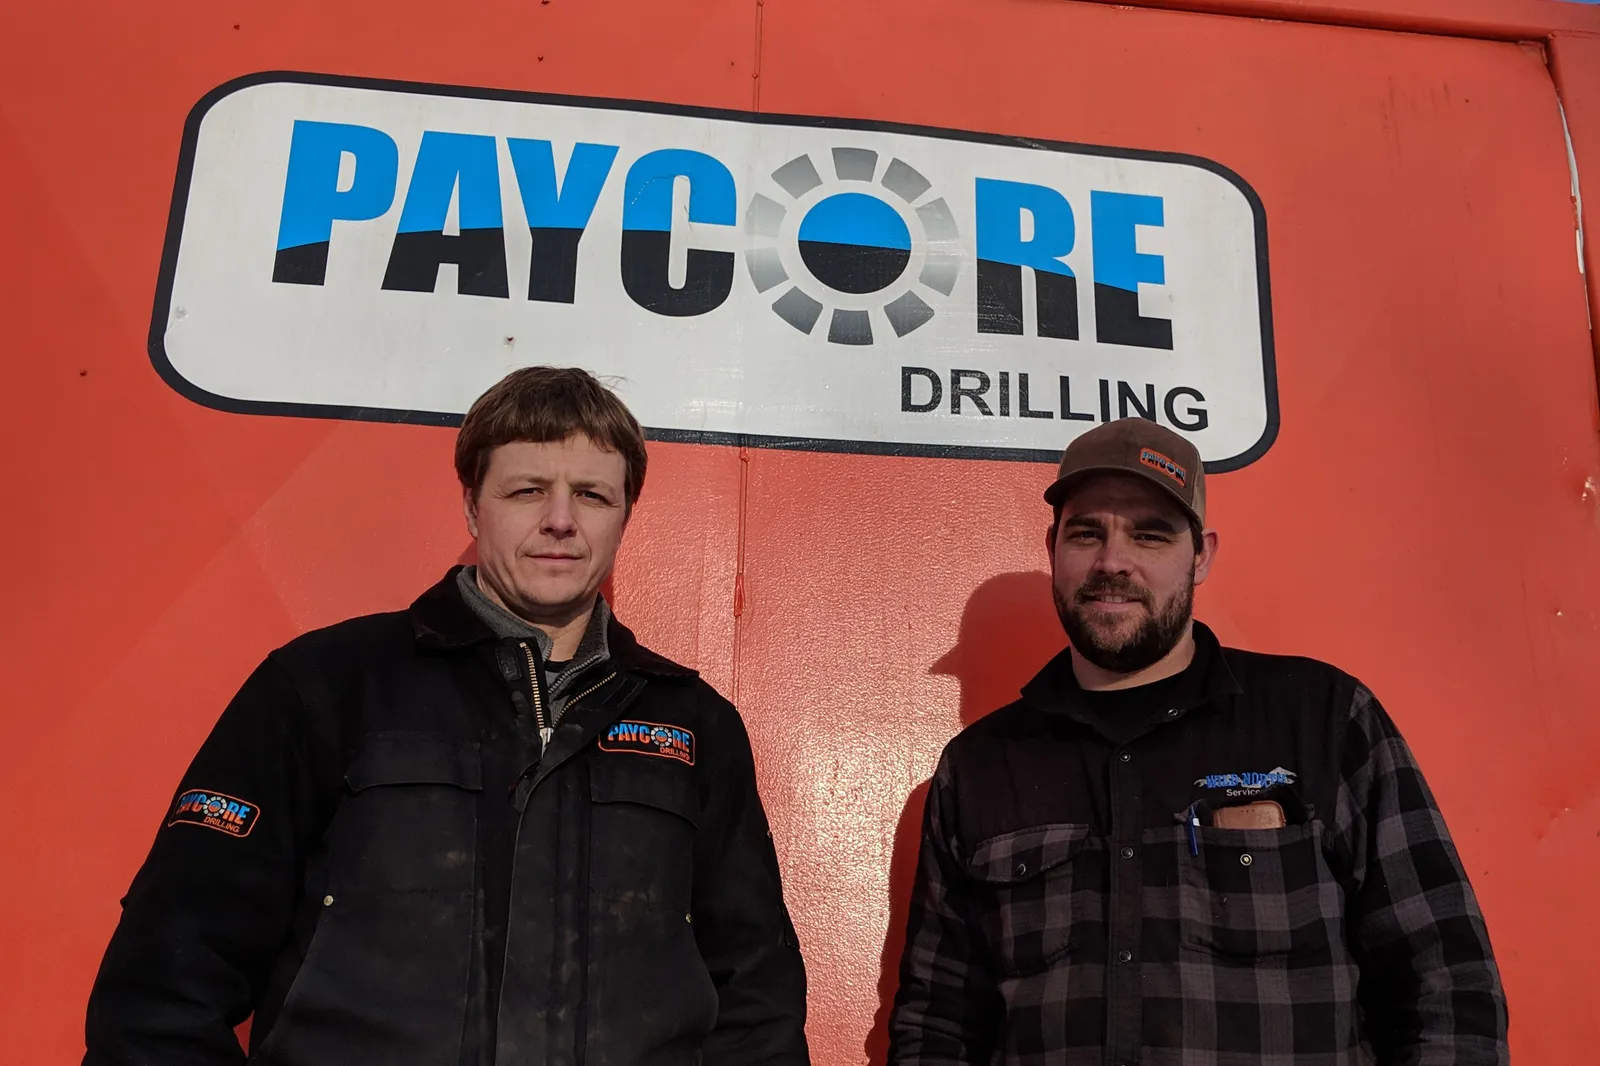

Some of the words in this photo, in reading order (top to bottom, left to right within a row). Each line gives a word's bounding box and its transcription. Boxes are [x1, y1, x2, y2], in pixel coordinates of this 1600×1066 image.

[271, 119, 1174, 350] PAYCORE
[901, 366, 1209, 431] DRILLING
[607, 723, 690, 753] PAYCORE
[659, 745, 690, 761] DRILLING
[203, 816, 240, 833] DRILLING
